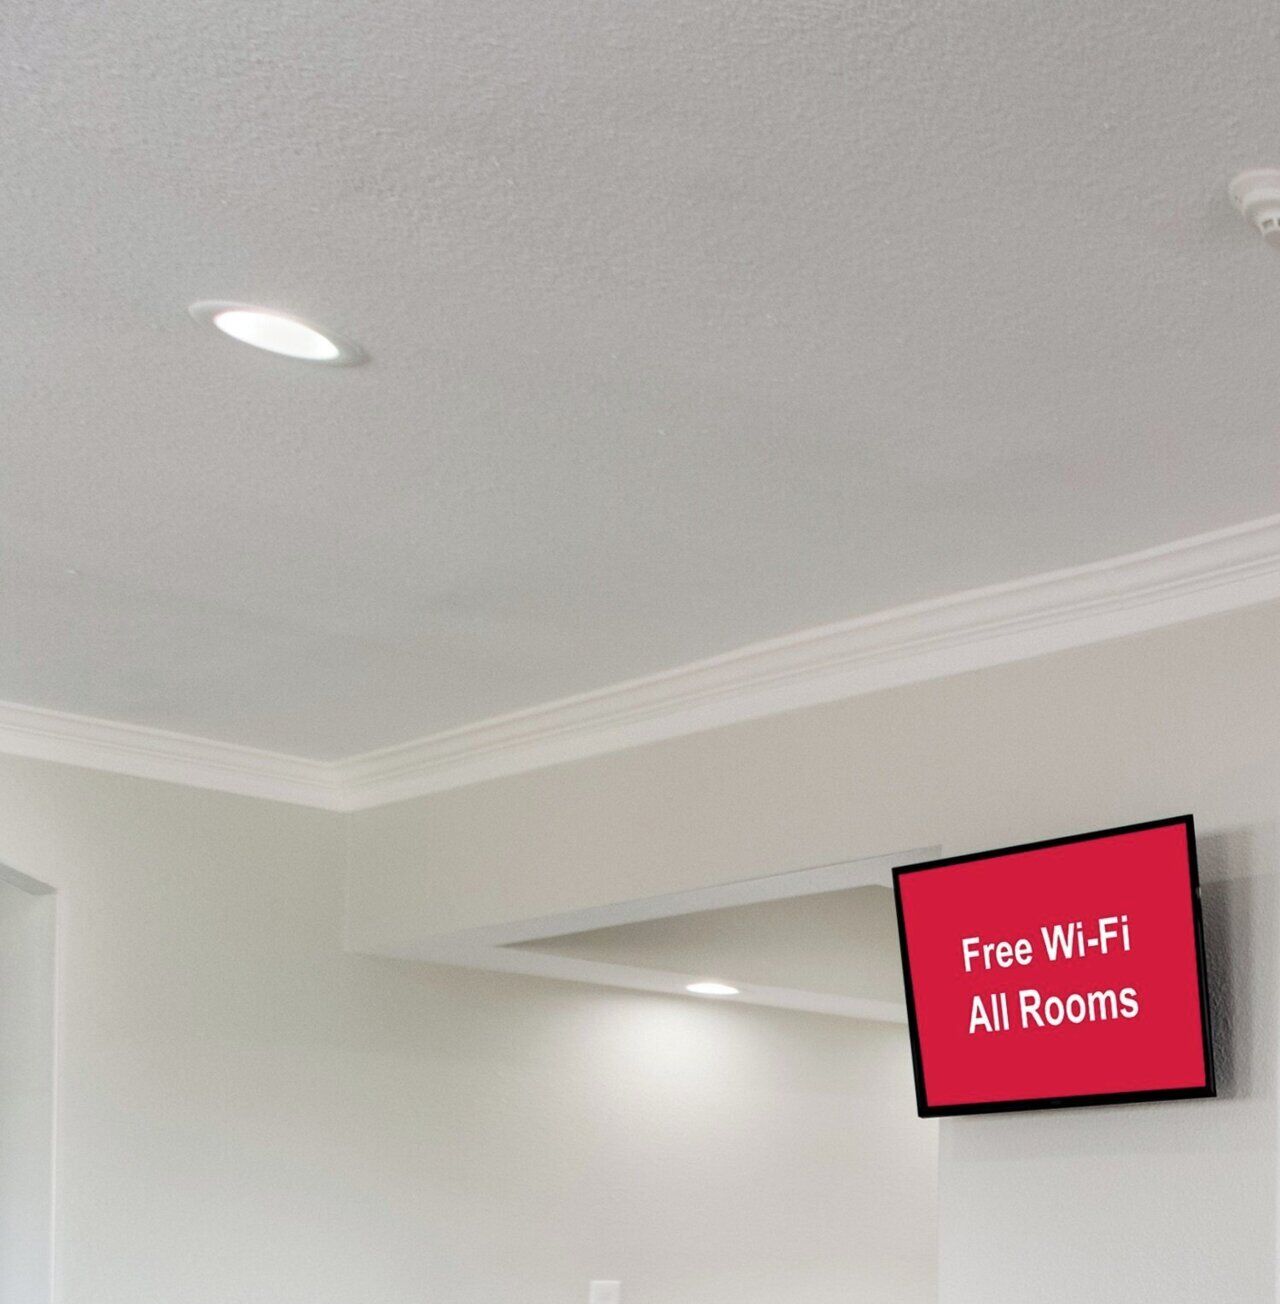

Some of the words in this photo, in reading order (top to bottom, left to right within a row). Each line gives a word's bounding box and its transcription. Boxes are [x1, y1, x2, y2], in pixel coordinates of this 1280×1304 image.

[962, 936, 1033, 973] Free
[1040, 914, 1131, 961] Wi-Fi
[969, 992, 1010, 1034] All
[1018, 987, 1139, 1029] Rooms
